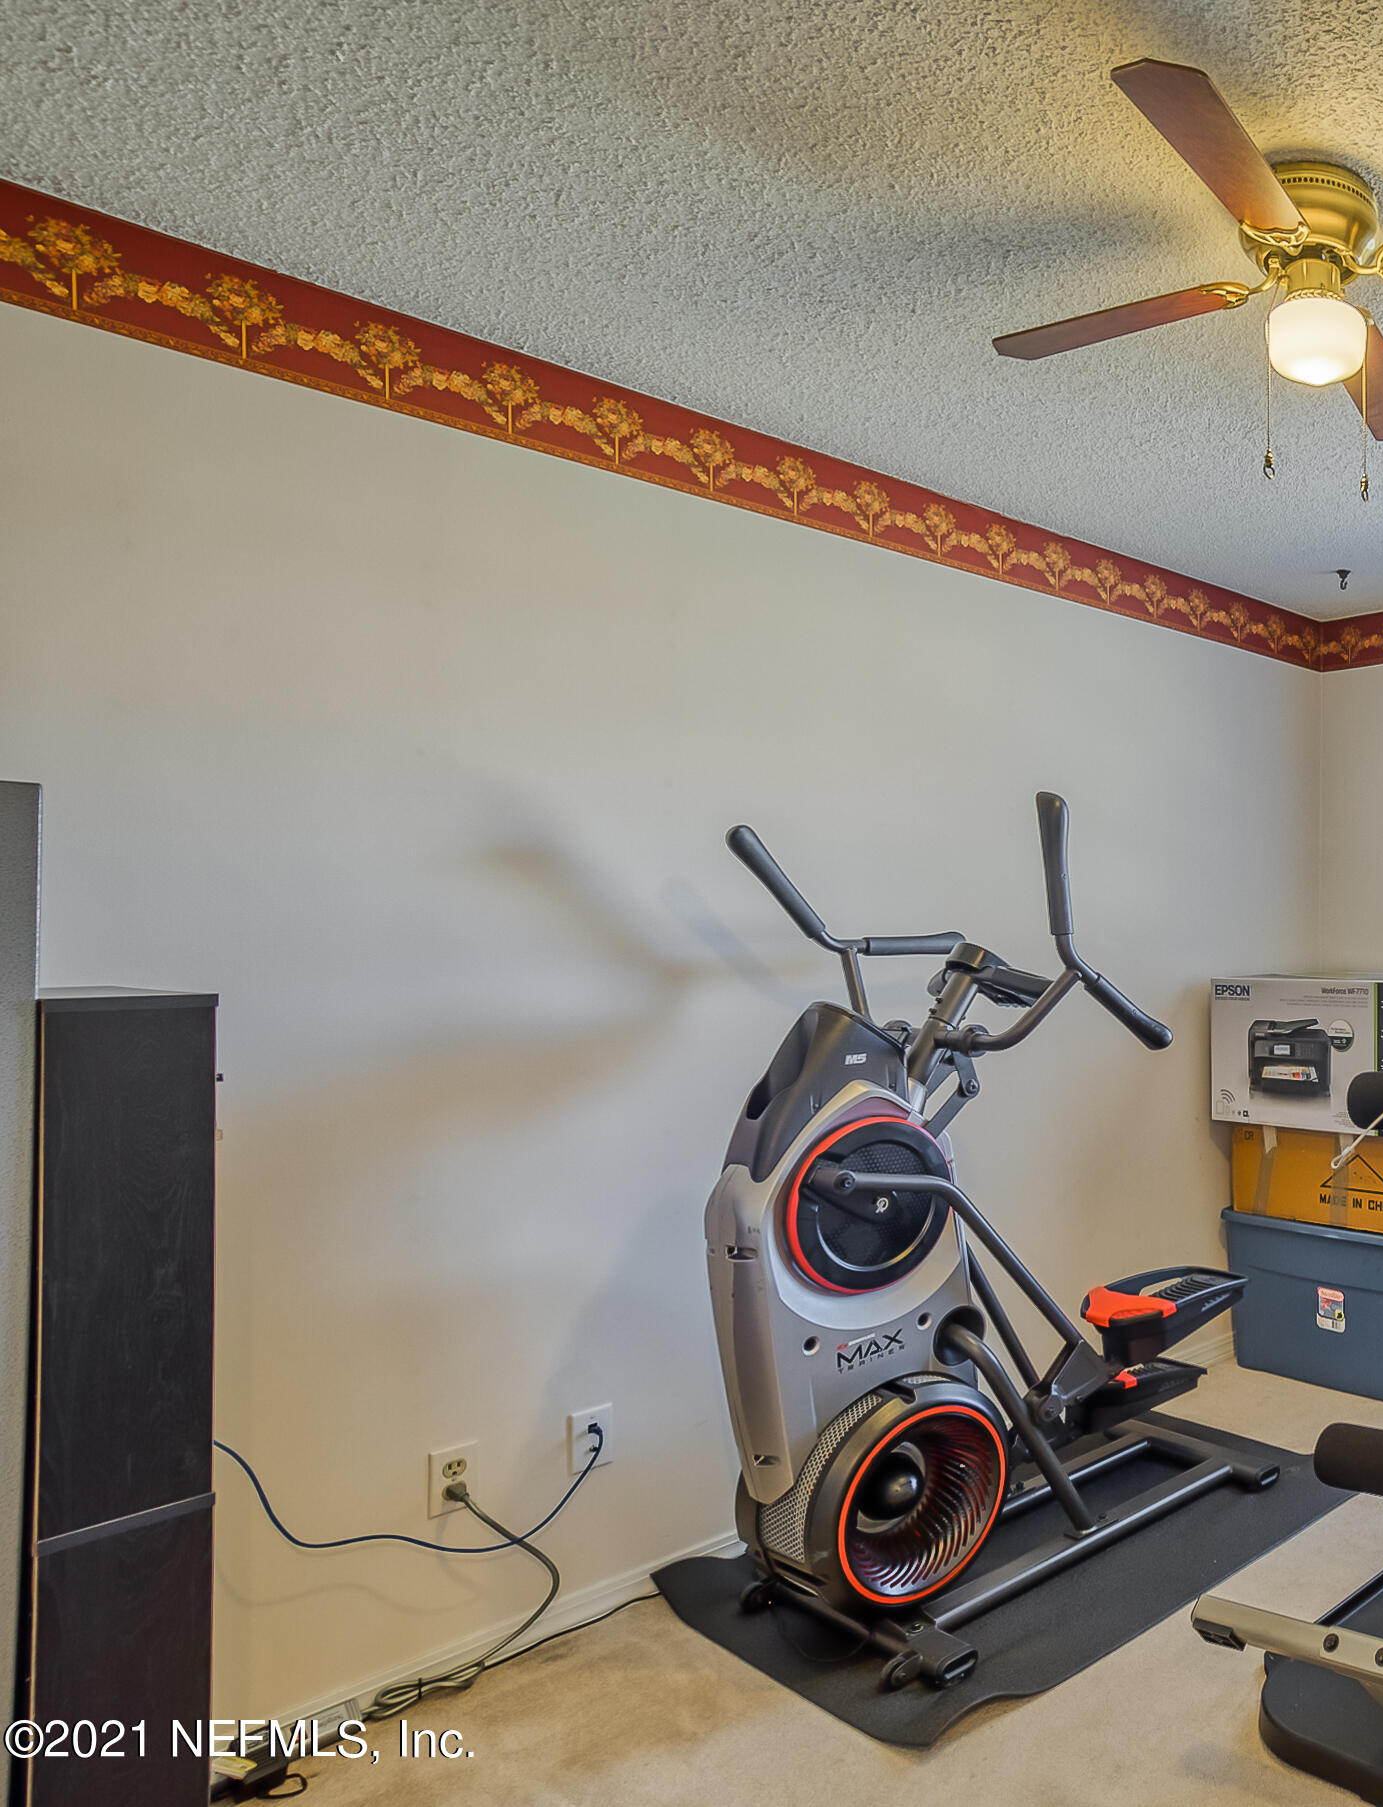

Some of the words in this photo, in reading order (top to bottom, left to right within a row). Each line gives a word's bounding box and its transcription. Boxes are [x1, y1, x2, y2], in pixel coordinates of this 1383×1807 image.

[1214, 984, 1250, 996] EPSON
[844, 1053, 867, 1065] M5
[1352, 1197, 1363, 1209] IN
[836, 1328, 904, 1368] MAX
[838, 1344, 905, 1374] TRAINER
